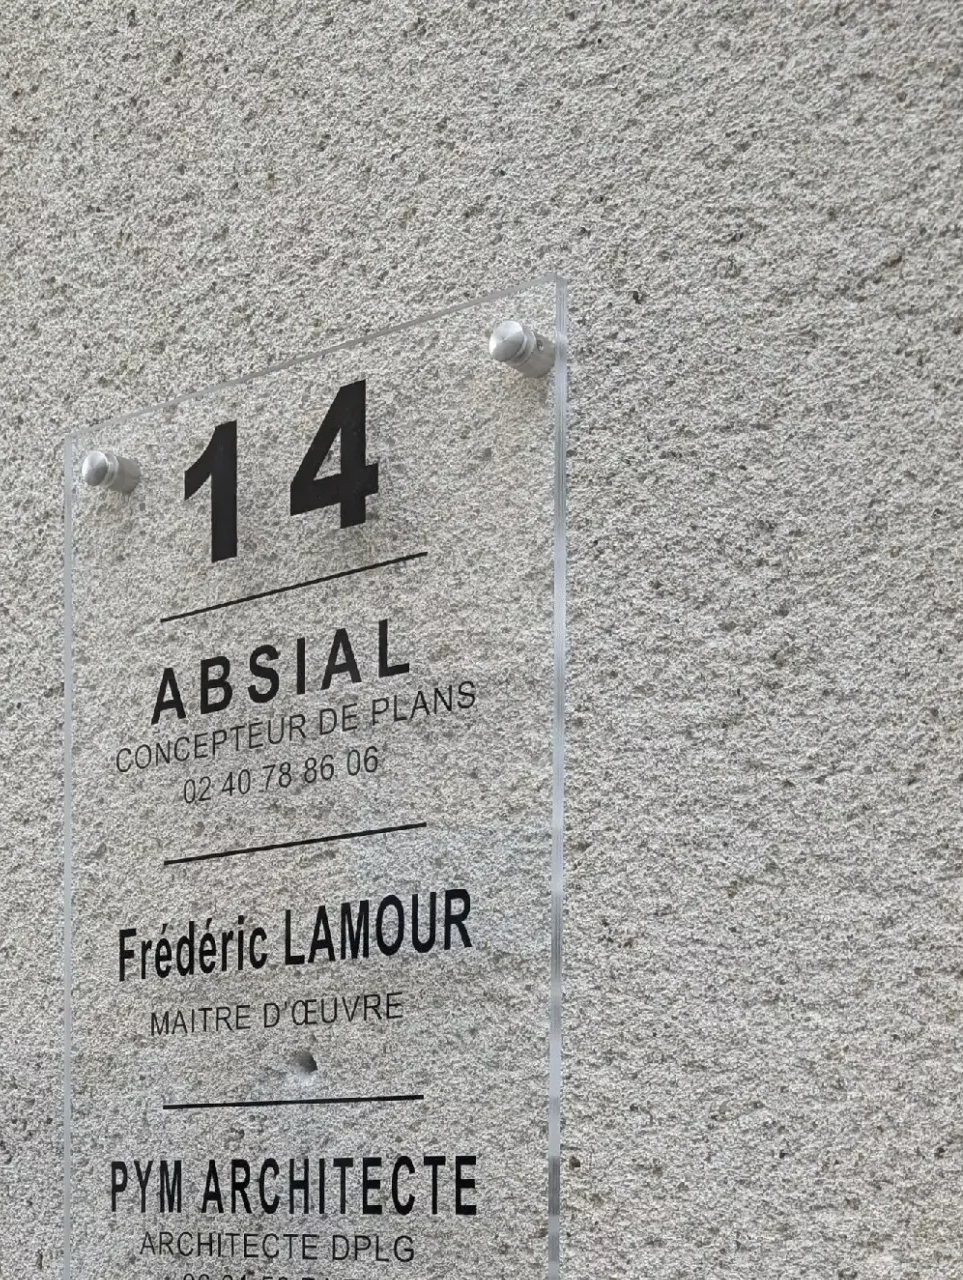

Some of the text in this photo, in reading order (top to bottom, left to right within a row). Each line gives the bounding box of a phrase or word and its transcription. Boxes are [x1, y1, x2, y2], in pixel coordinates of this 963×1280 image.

[151, 619, 410, 725] ABSIAL
[116, 680, 477, 773] CONCEPTEUR DE PLANS
[183, 746, 379, 804] 02 40 78 86 06
[118, 888, 473, 982] Frédéric LAMOUR
[150, 1004, 251, 1037] MAITRE
[111, 1155, 477, 1216] PYM ARCHITECTE
[139, 1231, 415, 1263] ARCHITECTE DPLG
